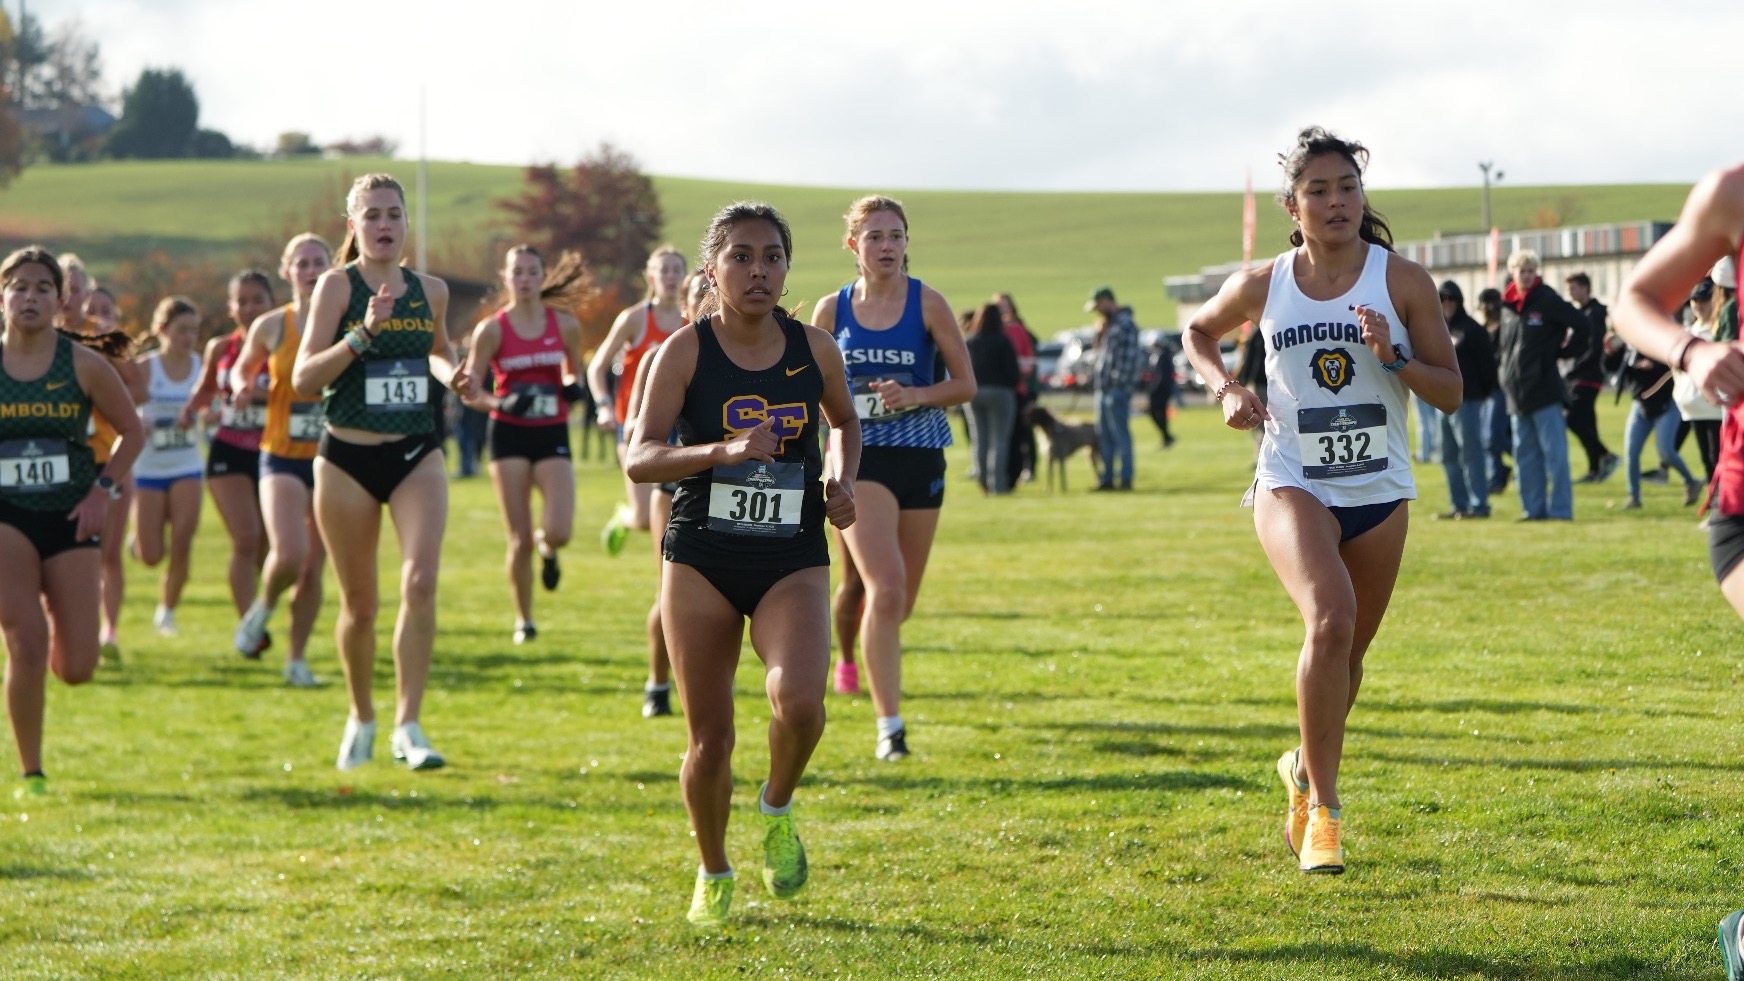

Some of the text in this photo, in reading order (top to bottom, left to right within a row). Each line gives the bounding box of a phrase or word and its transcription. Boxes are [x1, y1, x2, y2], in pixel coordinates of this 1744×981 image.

[1272, 322, 1366, 352] VANGUA
[382, 381, 418, 404] 143
[0, 402, 81, 418] MBOLDT
[1318, 432, 1372, 465] 332
[14, 461, 54, 485] 140
[729, 489, 783, 524] 301
